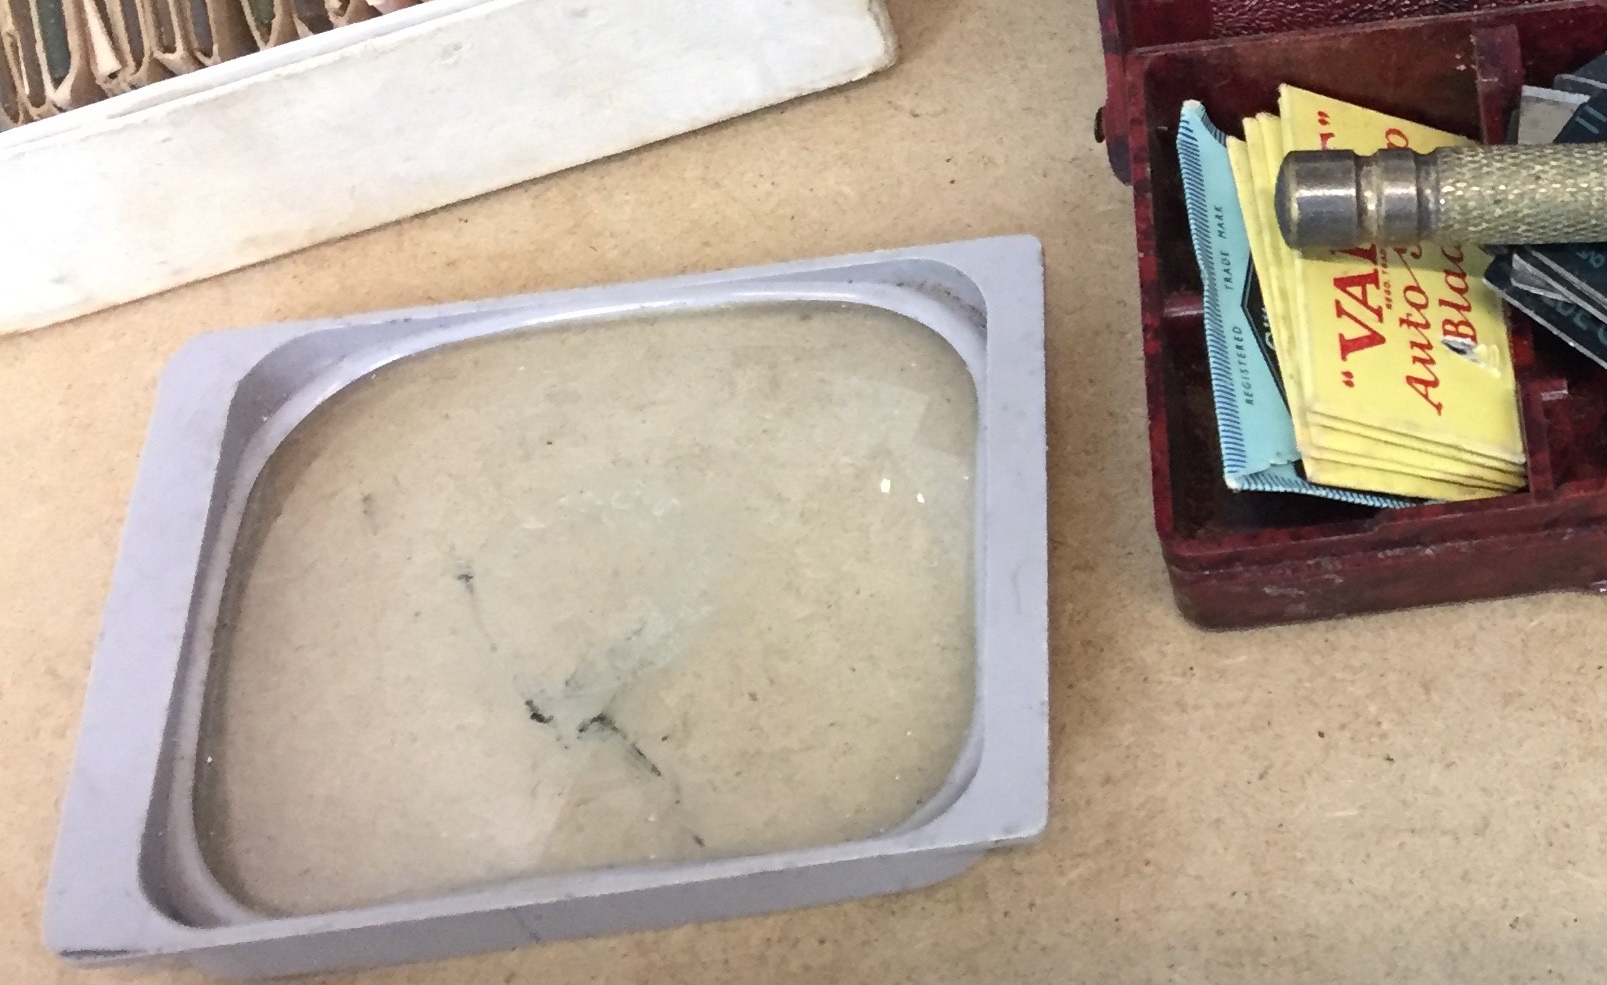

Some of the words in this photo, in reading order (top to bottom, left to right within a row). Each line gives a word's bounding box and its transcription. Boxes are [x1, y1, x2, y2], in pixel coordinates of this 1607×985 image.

[1213, 205, 1227, 239] MARK
[1218, 251, 1235, 291] TRADE
[1231, 325, 1255, 406] REGISTERED
